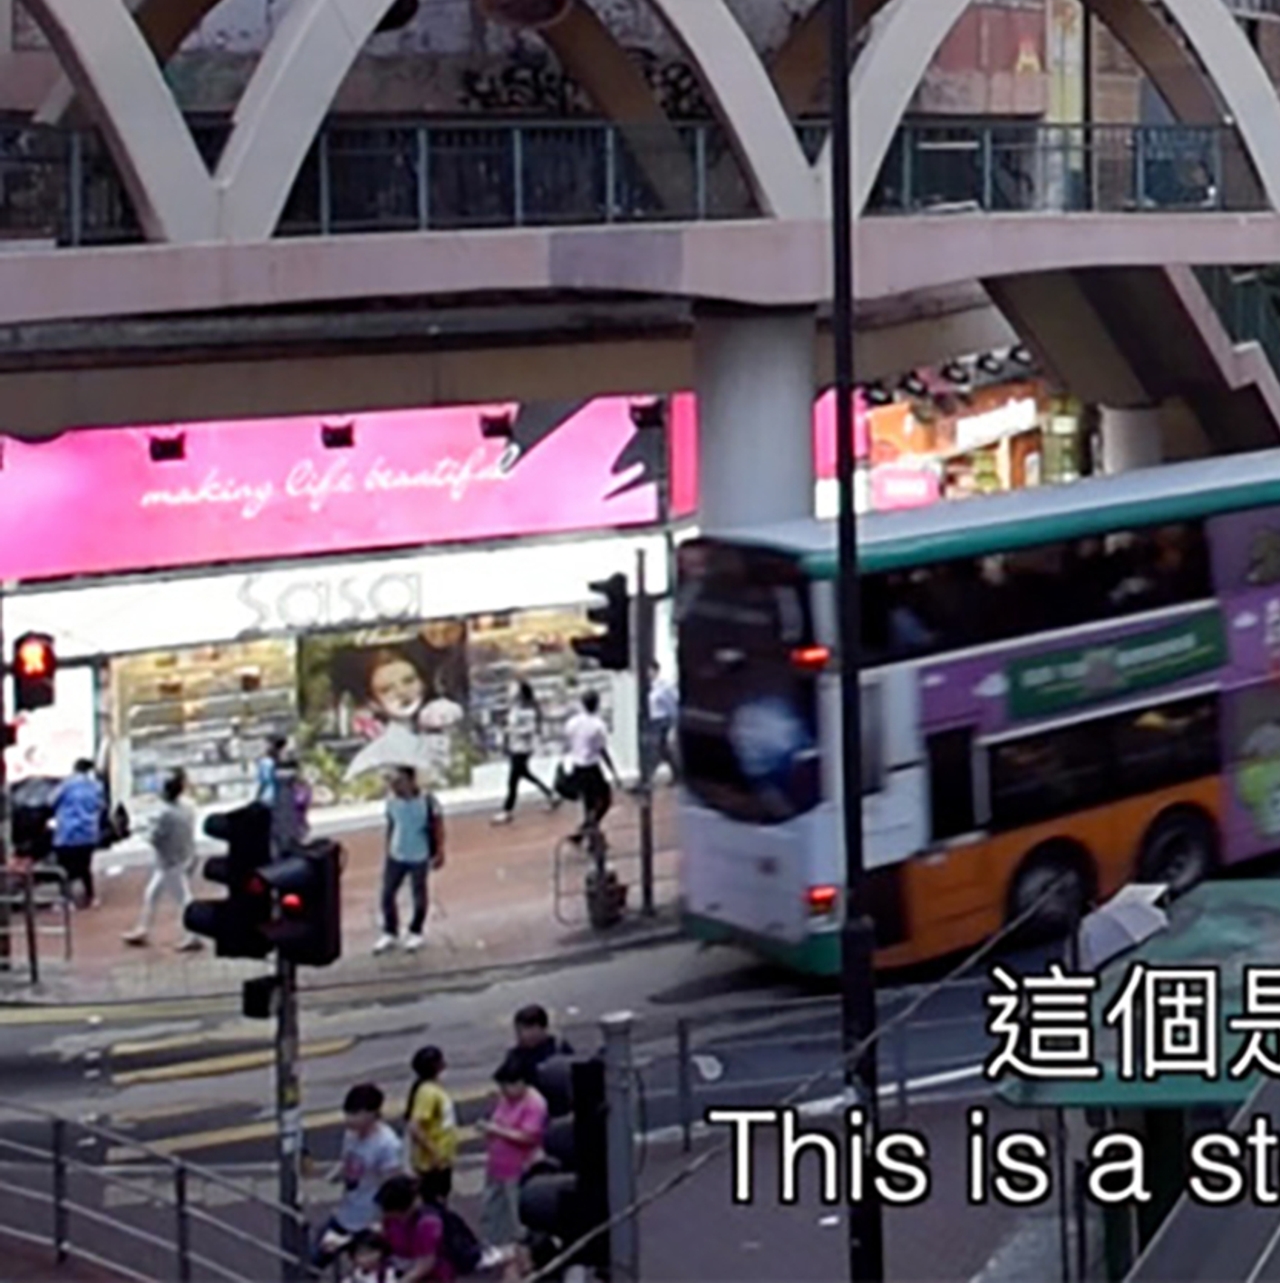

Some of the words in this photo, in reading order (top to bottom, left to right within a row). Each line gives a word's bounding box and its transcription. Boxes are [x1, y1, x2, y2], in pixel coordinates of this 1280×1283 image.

[140, 467, 275, 519] making
[285, 459, 354, 512] life
[363, 443, 520, 502] beautiful
